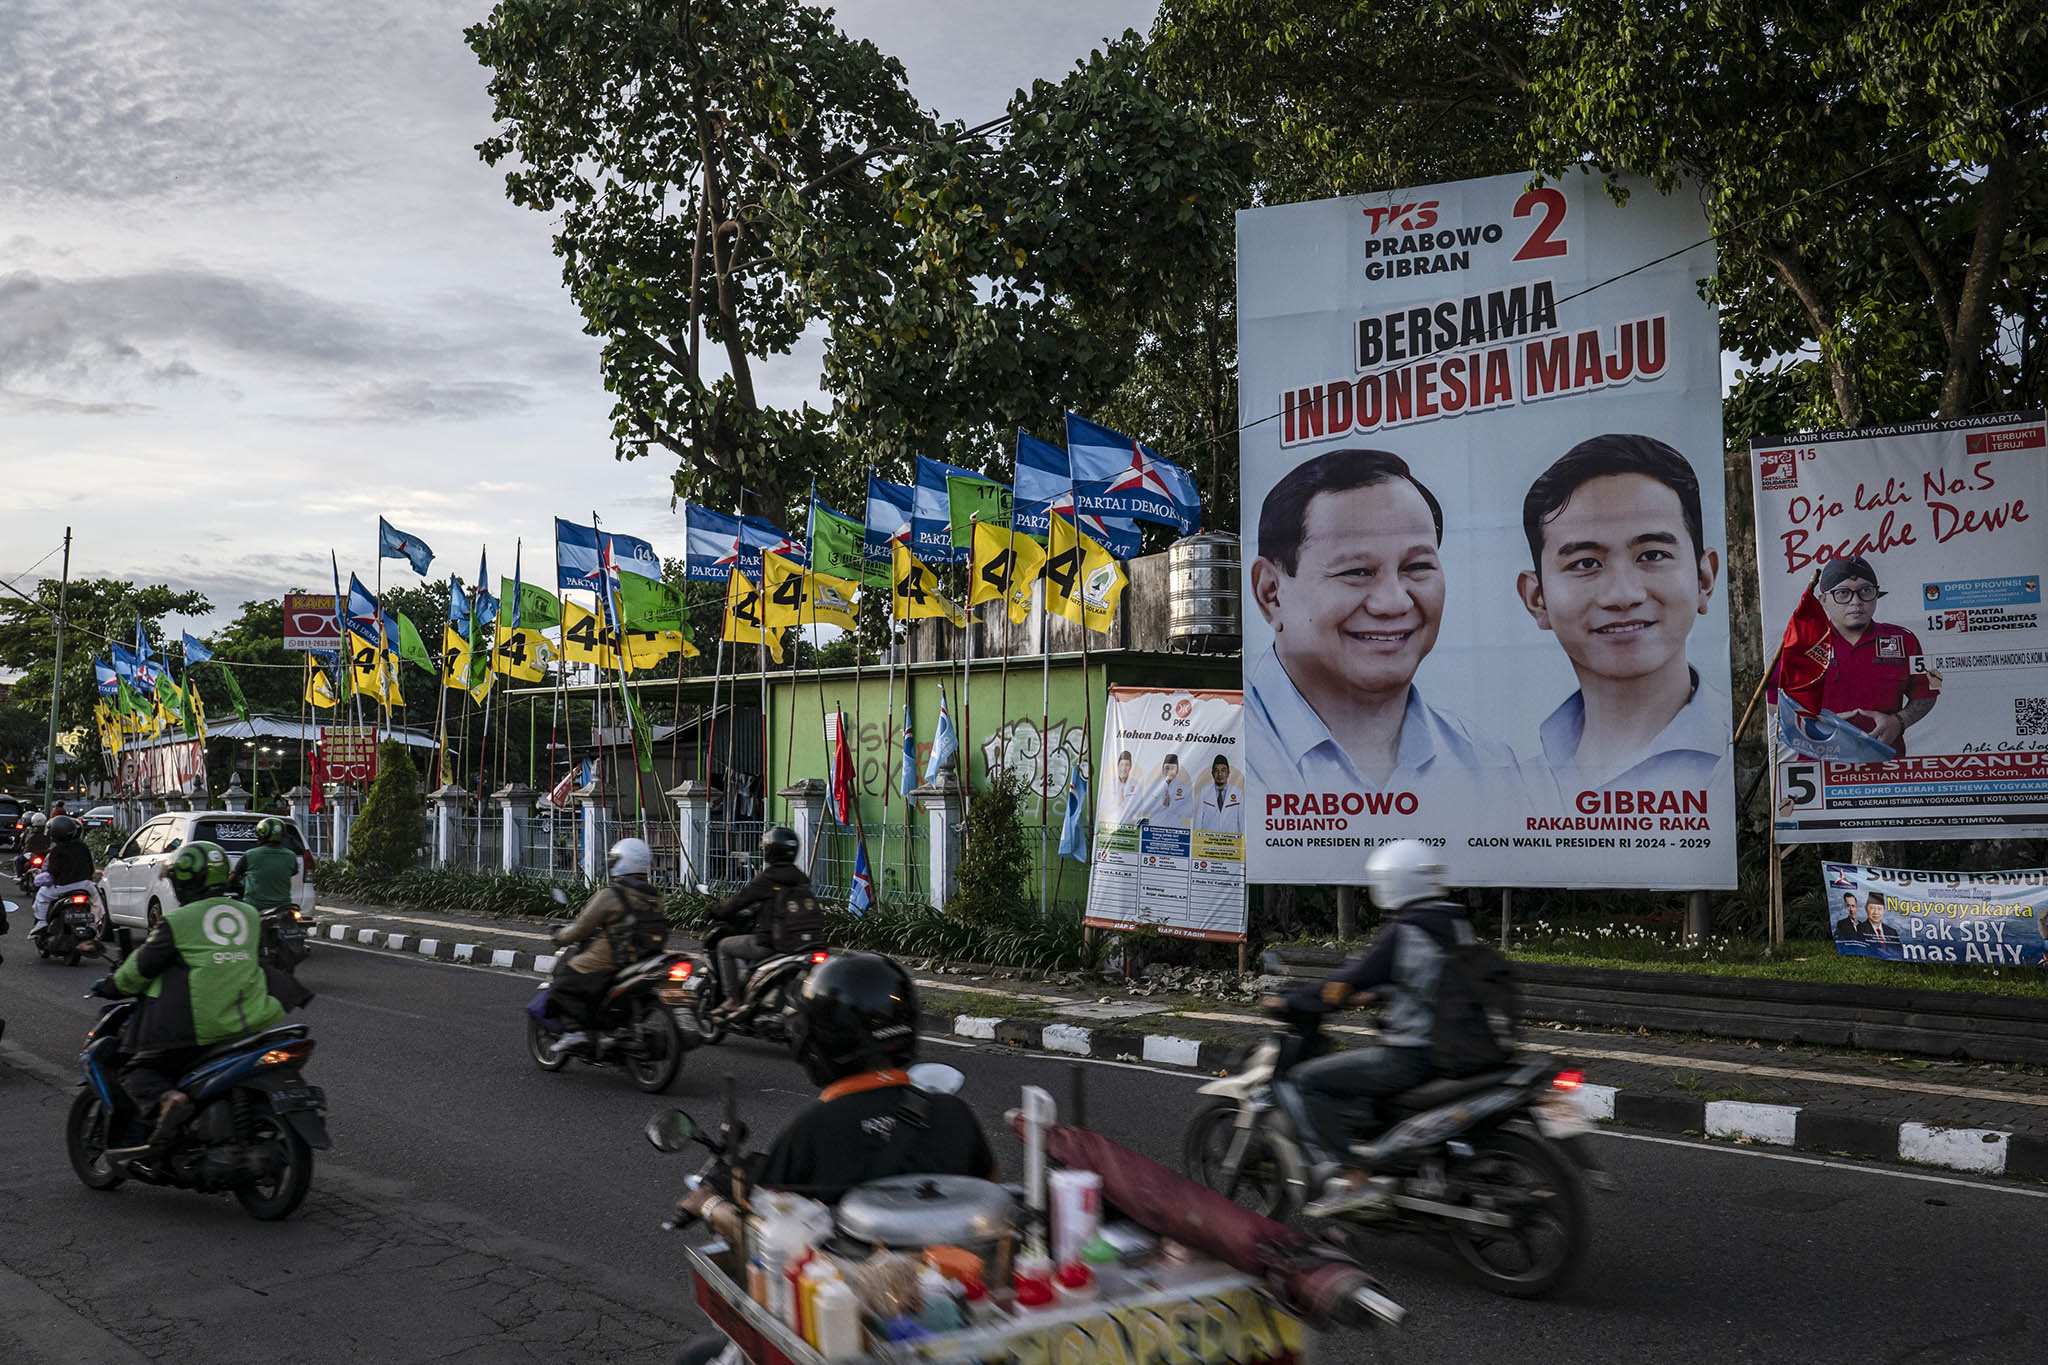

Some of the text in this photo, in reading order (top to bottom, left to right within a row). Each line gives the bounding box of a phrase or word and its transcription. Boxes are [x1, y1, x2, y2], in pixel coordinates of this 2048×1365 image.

[1362, 200, 1440, 235] TKS
[1512, 187, 1568, 262] 2
[1365, 224, 1502, 258] PRABOWO
[1365, 251, 1470, 281] GIBRAN
[1358, 280, 1558, 368] BERSAMA
[1285, 316, 1667, 443] INDONESIA MAJU
[1783, 414, 2022, 444] HADIR KERJA NYATA UNTUK YOGYAKARTA
[1991, 430, 2037, 442] TERBUKTI
[1992, 441, 2024, 450] TERUJI
[1798, 448, 1817, 461] 15
[1078, 495, 1126, 510] PARTAI
[1927, 499, 2029, 543] Dewe
[638, 549, 652, 560] 14
[982, 548, 1018, 595] 4
[1047, 546, 1087, 600] 4
[566, 577, 599, 590] PARTAI
[773, 572, 808, 611] 4
[897, 565, 928, 605] 4
[1944, 584, 1972, 592] DPRD
[1974, 579, 2022, 589] PROVINSI
[732, 591, 762, 628] 4
[1968, 608, 2004, 616] PARTAI
[1928, 615, 1944, 631] 15
[1968, 614, 2038, 624] SOLIDARITAS
[1968, 622, 2038, 632] INDONESIA
[566, 614, 598, 652] 4
[500, 632, 527, 666] 4
[353, 647, 376, 674] 4
[1914, 656, 1926, 673] 5
[1161, 703, 1172, 721] 8
[1173, 719, 1191, 727] PKS
[1152, 731, 1174, 741] Doa
[1174, 733, 1184, 742] &
[1185, 732, 1236, 745] Dicoblos
[1830, 762, 1871, 772] Dr.
[1831, 772, 1900, 782] CHRISTIAN
[1904, 769, 1973, 780] HANDOKO
[1976, 768, 2027, 778] S.Kom.,
[1788, 766, 1816, 805] 5
[1831, 788, 1862, 796] CALEG
[1894, 786, 1934, 794] DAERAH
[1938, 784, 1990, 792] ISTIMEWA
[1265, 792, 1419, 816] PRABOWO
[1576, 790, 1708, 815] GIBRAN
[1890, 798, 1923, 806] ISTIMEWA
[1925, 796, 1974, 804] YOGYAKARTA
[1265, 817, 1348, 831] SUBIANTO
[1526, 816, 1710, 831] RAKABUMING RAKA
[1948, 816, 2005, 824] ISTIMEWA
[1265, 837, 1304, 848] CALON
[1306, 837, 1361, 848] PRESIDEN
[1364, 838, 1374, 847] RI
[1378, 838, 1405, 847] 20
[1468, 837, 1507, 848] CALON
[1512, 837, 1552, 848] WAKIL
[1556, 837, 1616, 848] PRESIDEN
[1619, 838, 1632, 848] RI
[1635, 838, 1666, 848] 2024
[1680, 838, 1711, 848] 2029
[1194, 862, 1200, 870] 8
[1867, 867, 1961, 888] Sugeng
[1886, 896, 2033, 919] Ngayogyakarta
[1911, 917, 1954, 941] Pak
[1960, 920, 2006, 944] SBY
[1902, 943, 2023, 965] mas AHY
